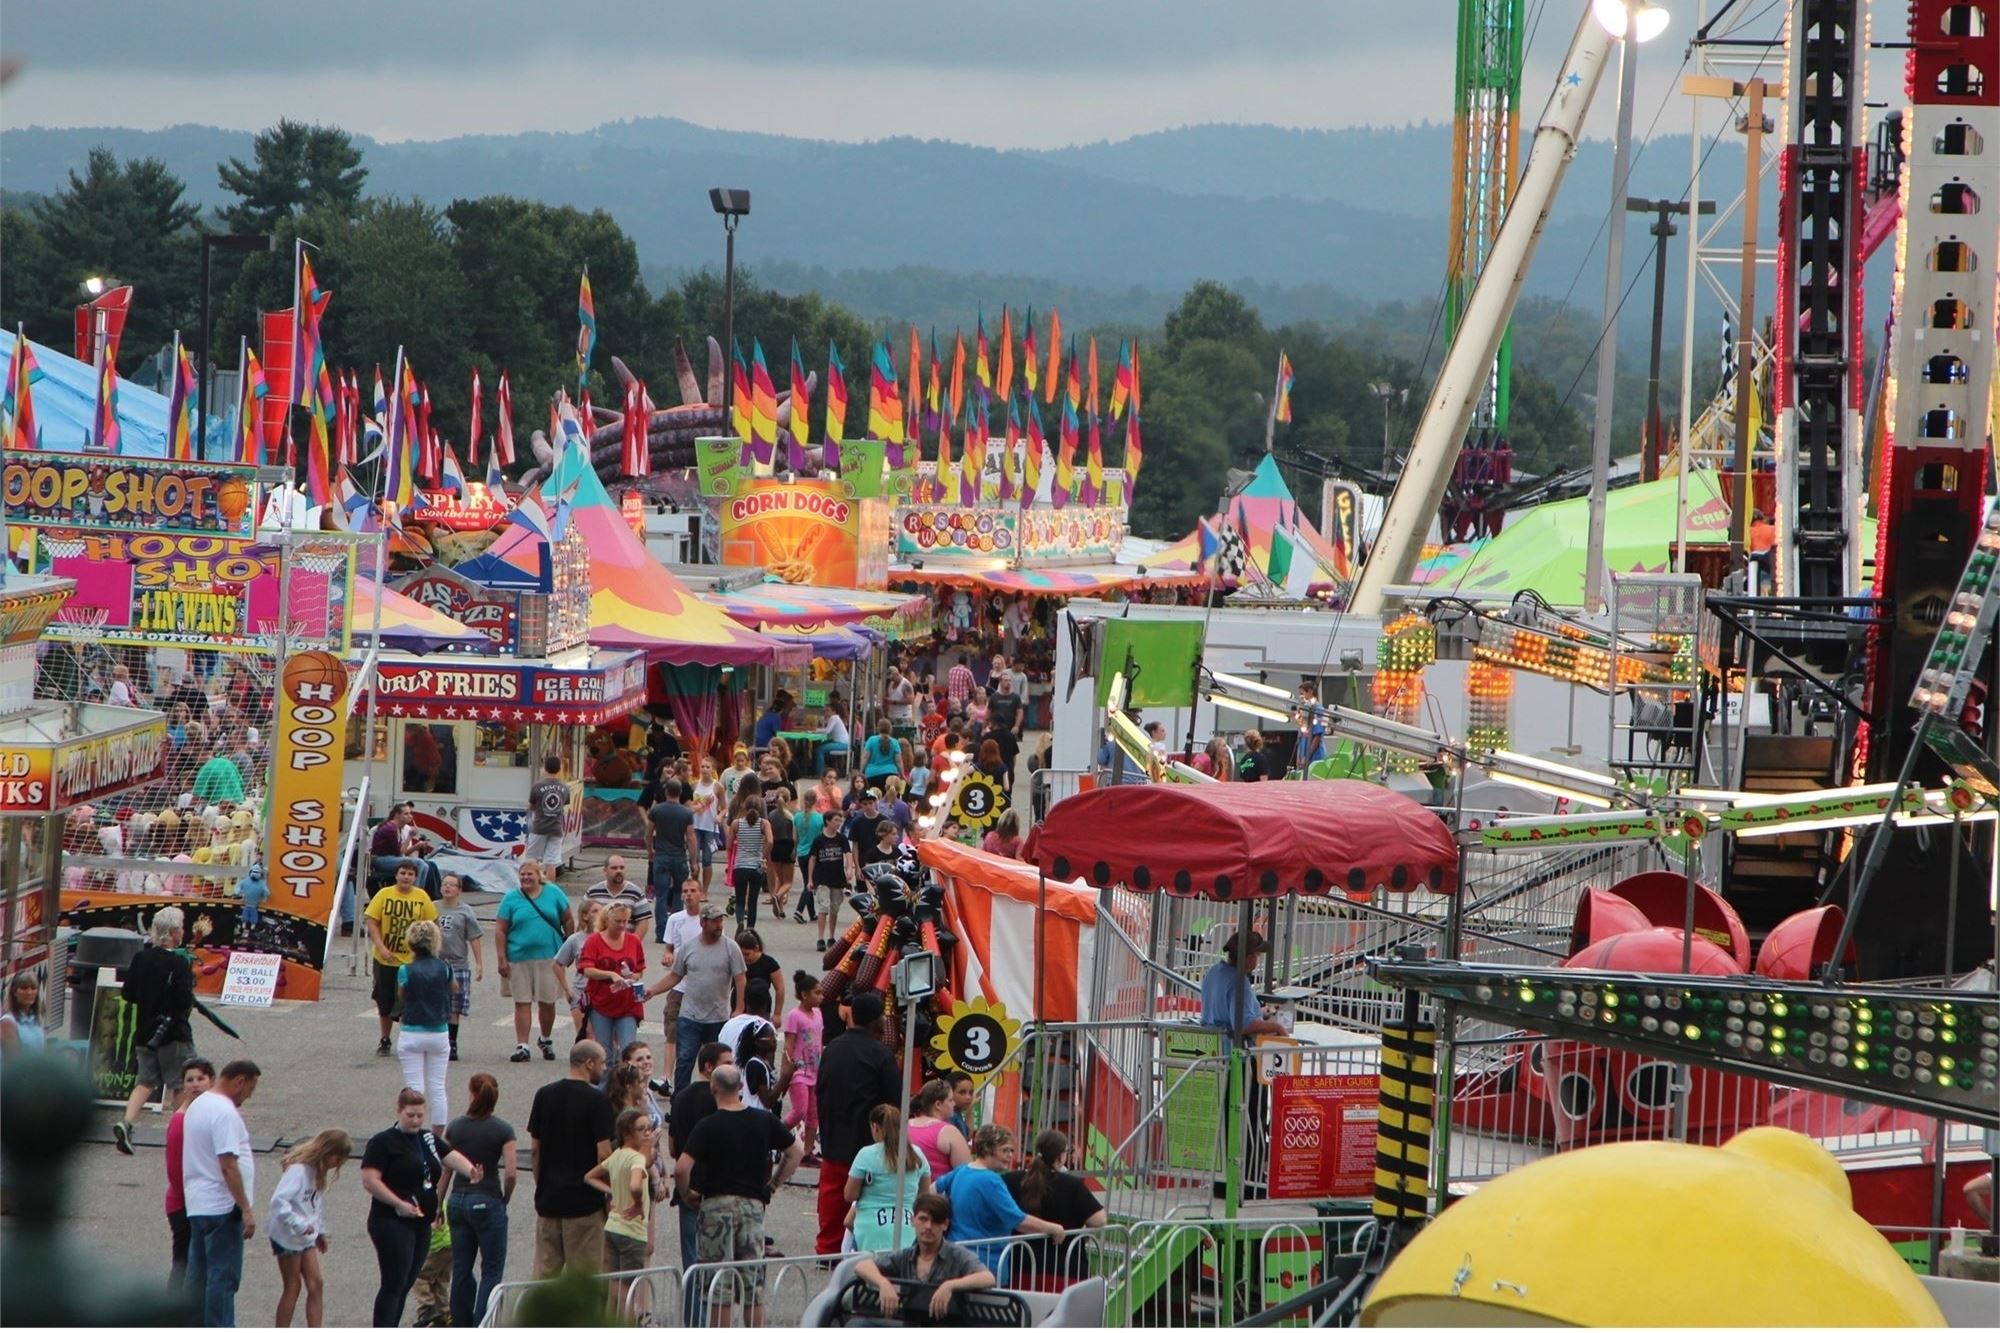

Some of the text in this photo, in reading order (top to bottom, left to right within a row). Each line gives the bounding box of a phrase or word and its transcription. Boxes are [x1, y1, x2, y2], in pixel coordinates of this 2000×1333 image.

[60, 456, 132, 467] OFFICIAL
[143, 460, 171, 470] NBA
[179, 463, 233, 475] HOOPS
[4, 465, 212, 519] OOP SHOT
[420, 508, 480, 520] Southern
[732, 492, 850, 524] CORN DOGS
[29, 514, 162, 530] ONE IN WINS
[905, 512, 993, 534] RISING
[918, 528, 1011, 552] WATERS
[153, 590, 178, 630] IN
[181, 592, 237, 635] WINS
[107, 629, 143, 640] ARE
[147, 632, 227, 646] OFFICIAL
[362, 669, 517, 698] URLY FRIES
[537, 677, 571, 691] ICE
[288, 680, 337, 771] HOOP
[0, 754, 31, 777] LD
[968, 789, 985, 810] 3
[280, 799, 329, 899] SHOT
[384, 898, 424, 919] DON'T
[389, 916, 416, 935] BR
[232, 954, 280, 966] Basketball
[229, 967, 275, 977] ONE BALL
[236, 976, 266, 986] $3.00
[224, 994, 270, 1004] PER DAY
[964, 1026, 991, 1061] 3
[960, 1061, 993, 1073] COUPONS
[1293, 1077, 1374, 1088] RIDE SAFETY GUIDE
